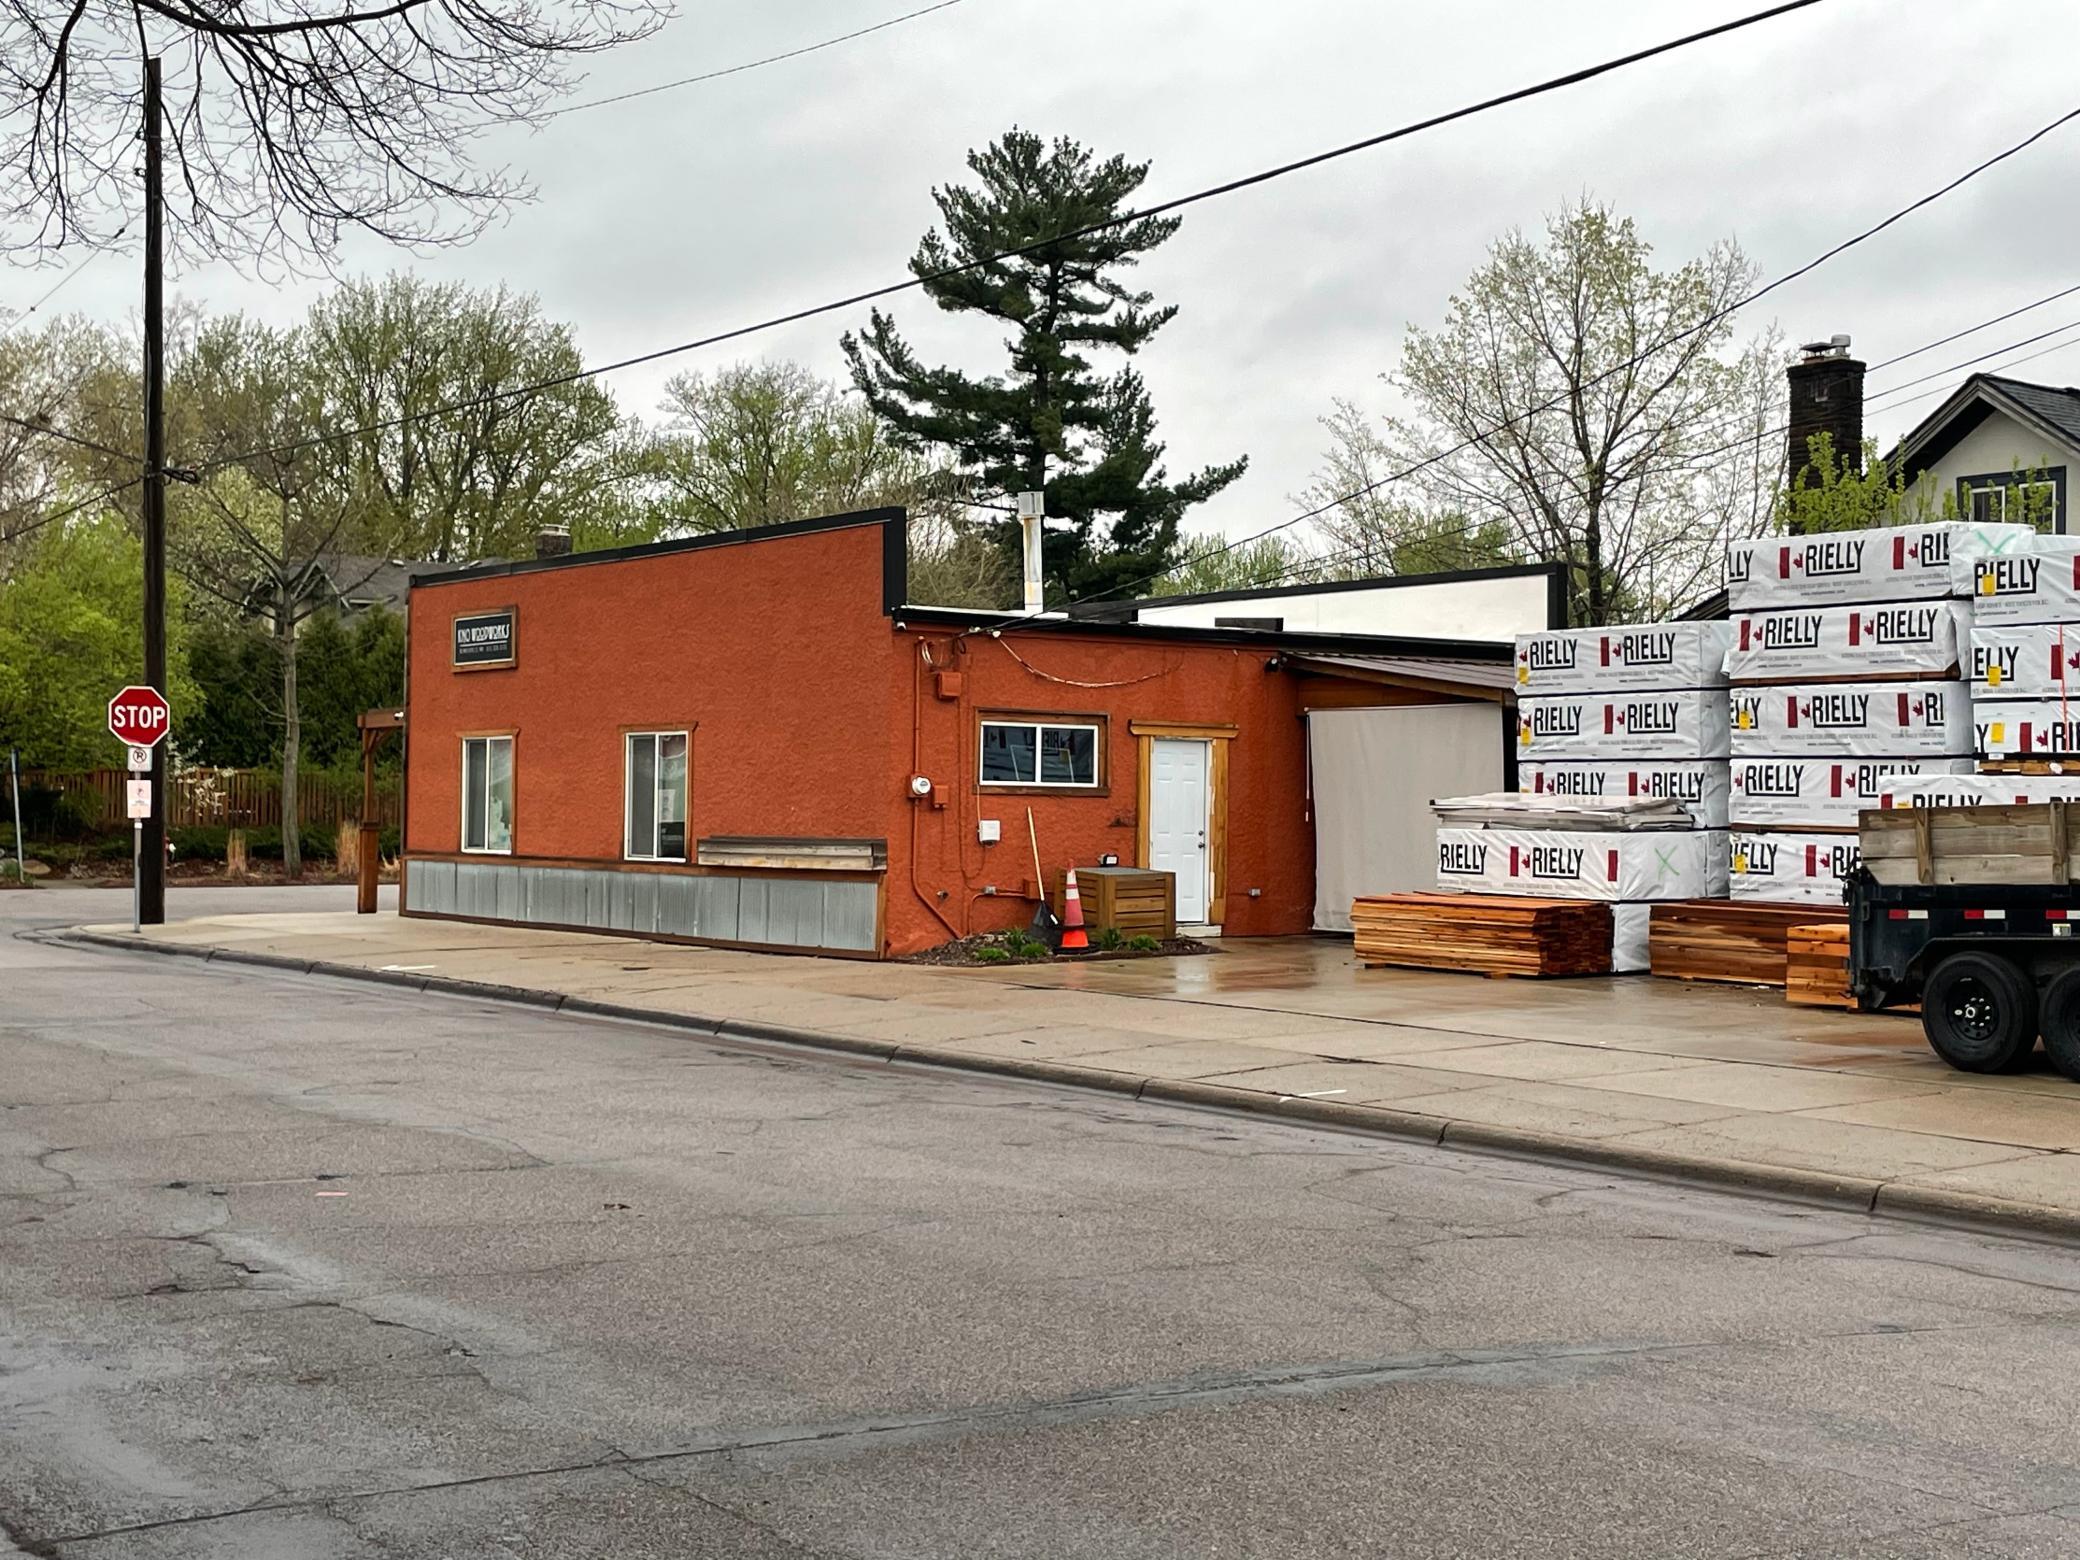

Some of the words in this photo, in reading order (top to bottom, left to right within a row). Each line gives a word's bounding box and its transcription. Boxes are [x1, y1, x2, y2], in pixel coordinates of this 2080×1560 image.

[1805, 539, 1866, 577] RIELLY
[1764, 615, 1823, 650] RIELLY
[1876, 608, 1938, 645] RIELLY
[1530, 638, 1578, 671] RIELLY
[1623, 632, 1676, 666] RIELLY
[113, 704, 166, 729] STOP
[1534, 705, 1582, 737] RIELLY
[1627, 702, 1679, 735] RIELLY
[1812, 694, 1870, 729] RIELLY
[1556, 771, 1606, 796] RIELLY
[1651, 771, 1705, 803] RIELLY
[1745, 764, 1804, 798] RIELLY
[1440, 843, 1488, 875] RIELLY
[1532, 846, 1584, 880] RIELLY
